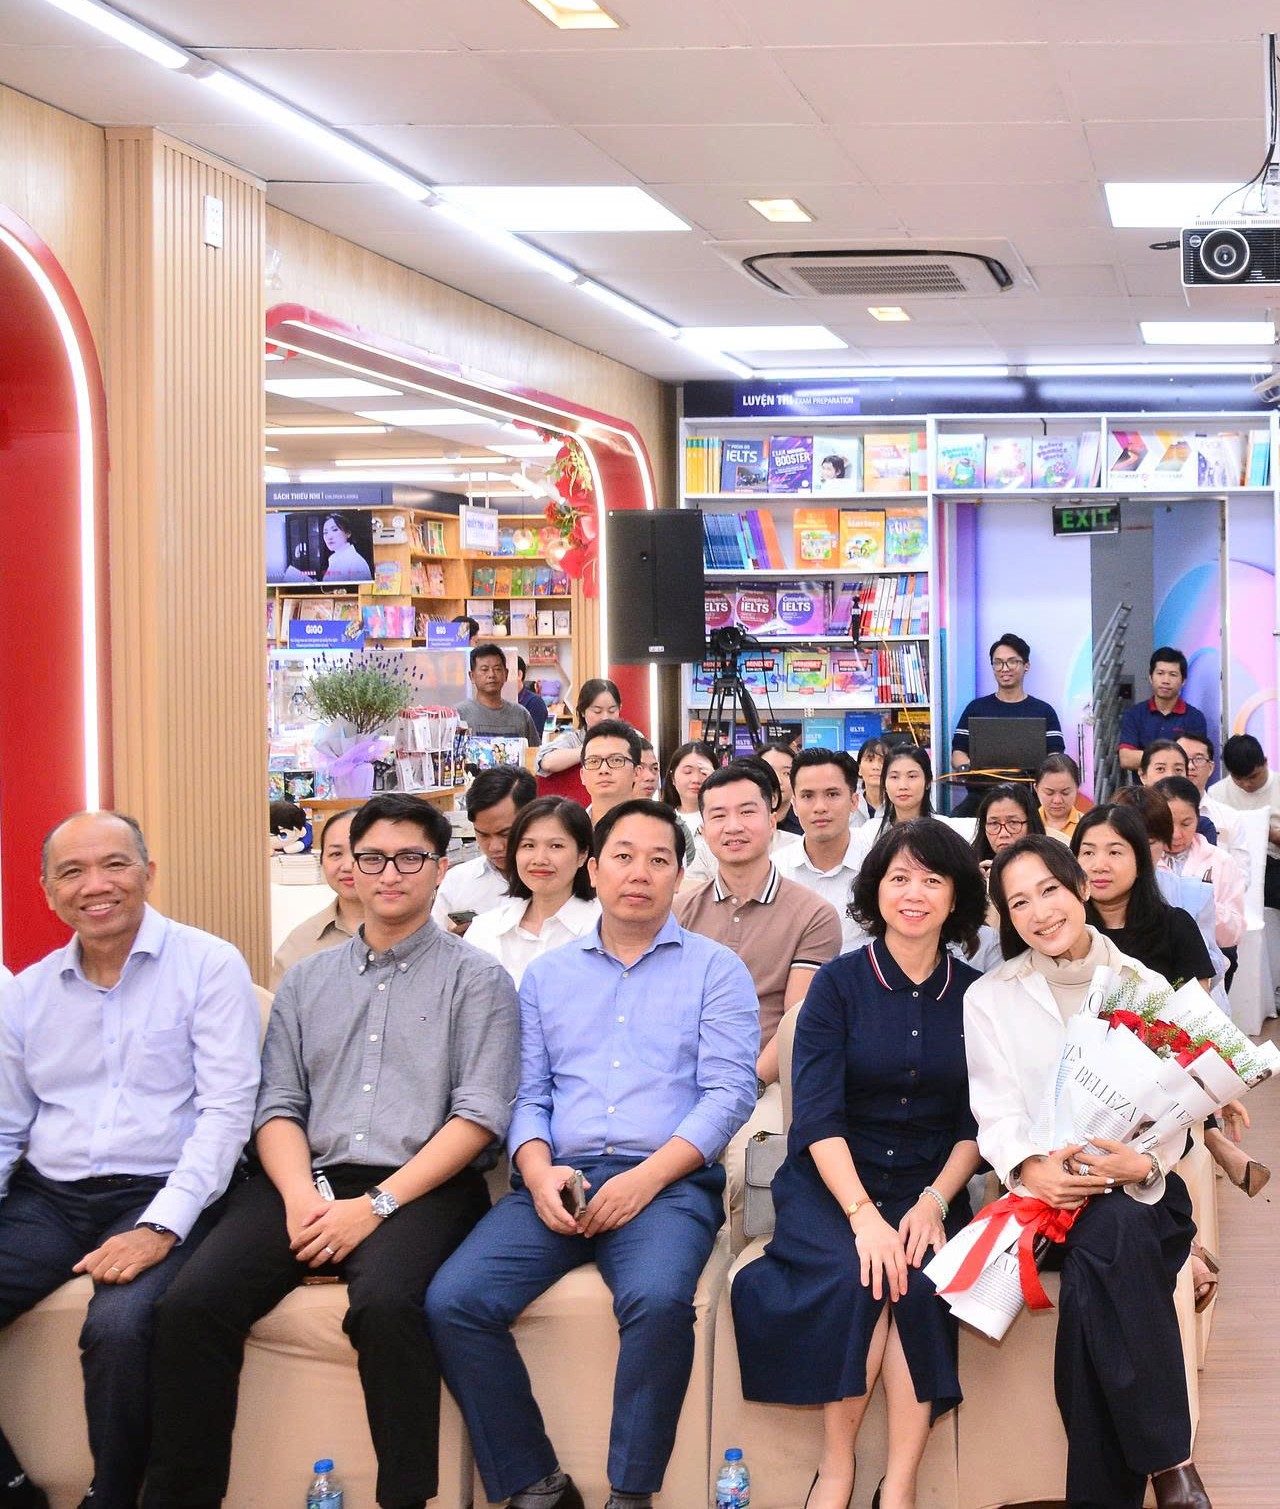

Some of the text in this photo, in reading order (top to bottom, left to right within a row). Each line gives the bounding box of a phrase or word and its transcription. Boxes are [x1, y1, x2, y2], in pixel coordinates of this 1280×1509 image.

[726, 450, 757, 463] IELTS
[775, 451, 811, 467] BOOSTER
[1061, 507, 1112, 530] EXIT
[705, 602, 729, 612] ELTS
[741, 602, 769, 613] IELTS
[782, 602, 811, 612] IELTS
[1074, 1066, 1137, 1122] BELLEZA
